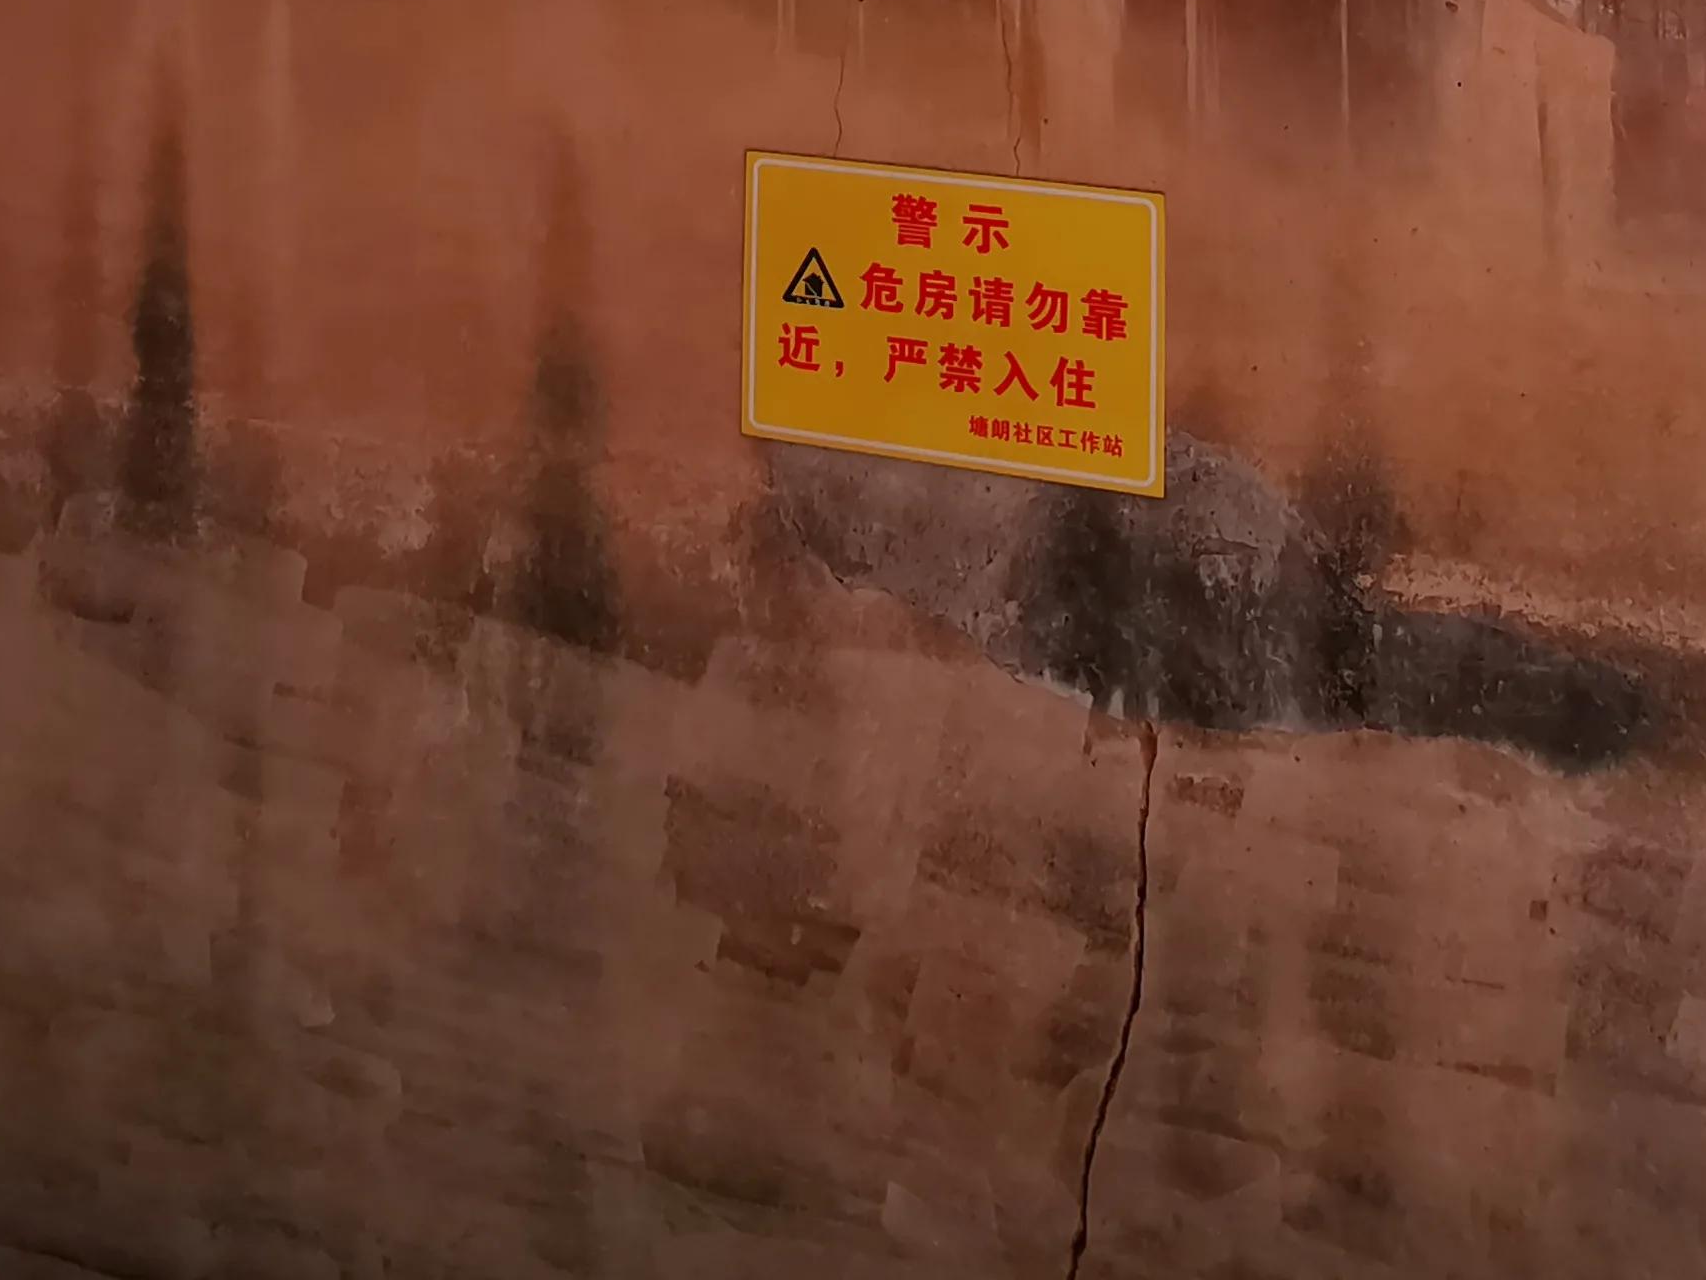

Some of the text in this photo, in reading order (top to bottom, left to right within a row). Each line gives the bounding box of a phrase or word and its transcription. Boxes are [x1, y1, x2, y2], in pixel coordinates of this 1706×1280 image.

[892, 194, 1010, 254] 警示
[860, 263, 1129, 341] 危房请勿靠
[968, 416, 1123, 457] 塘朗社区工作站
